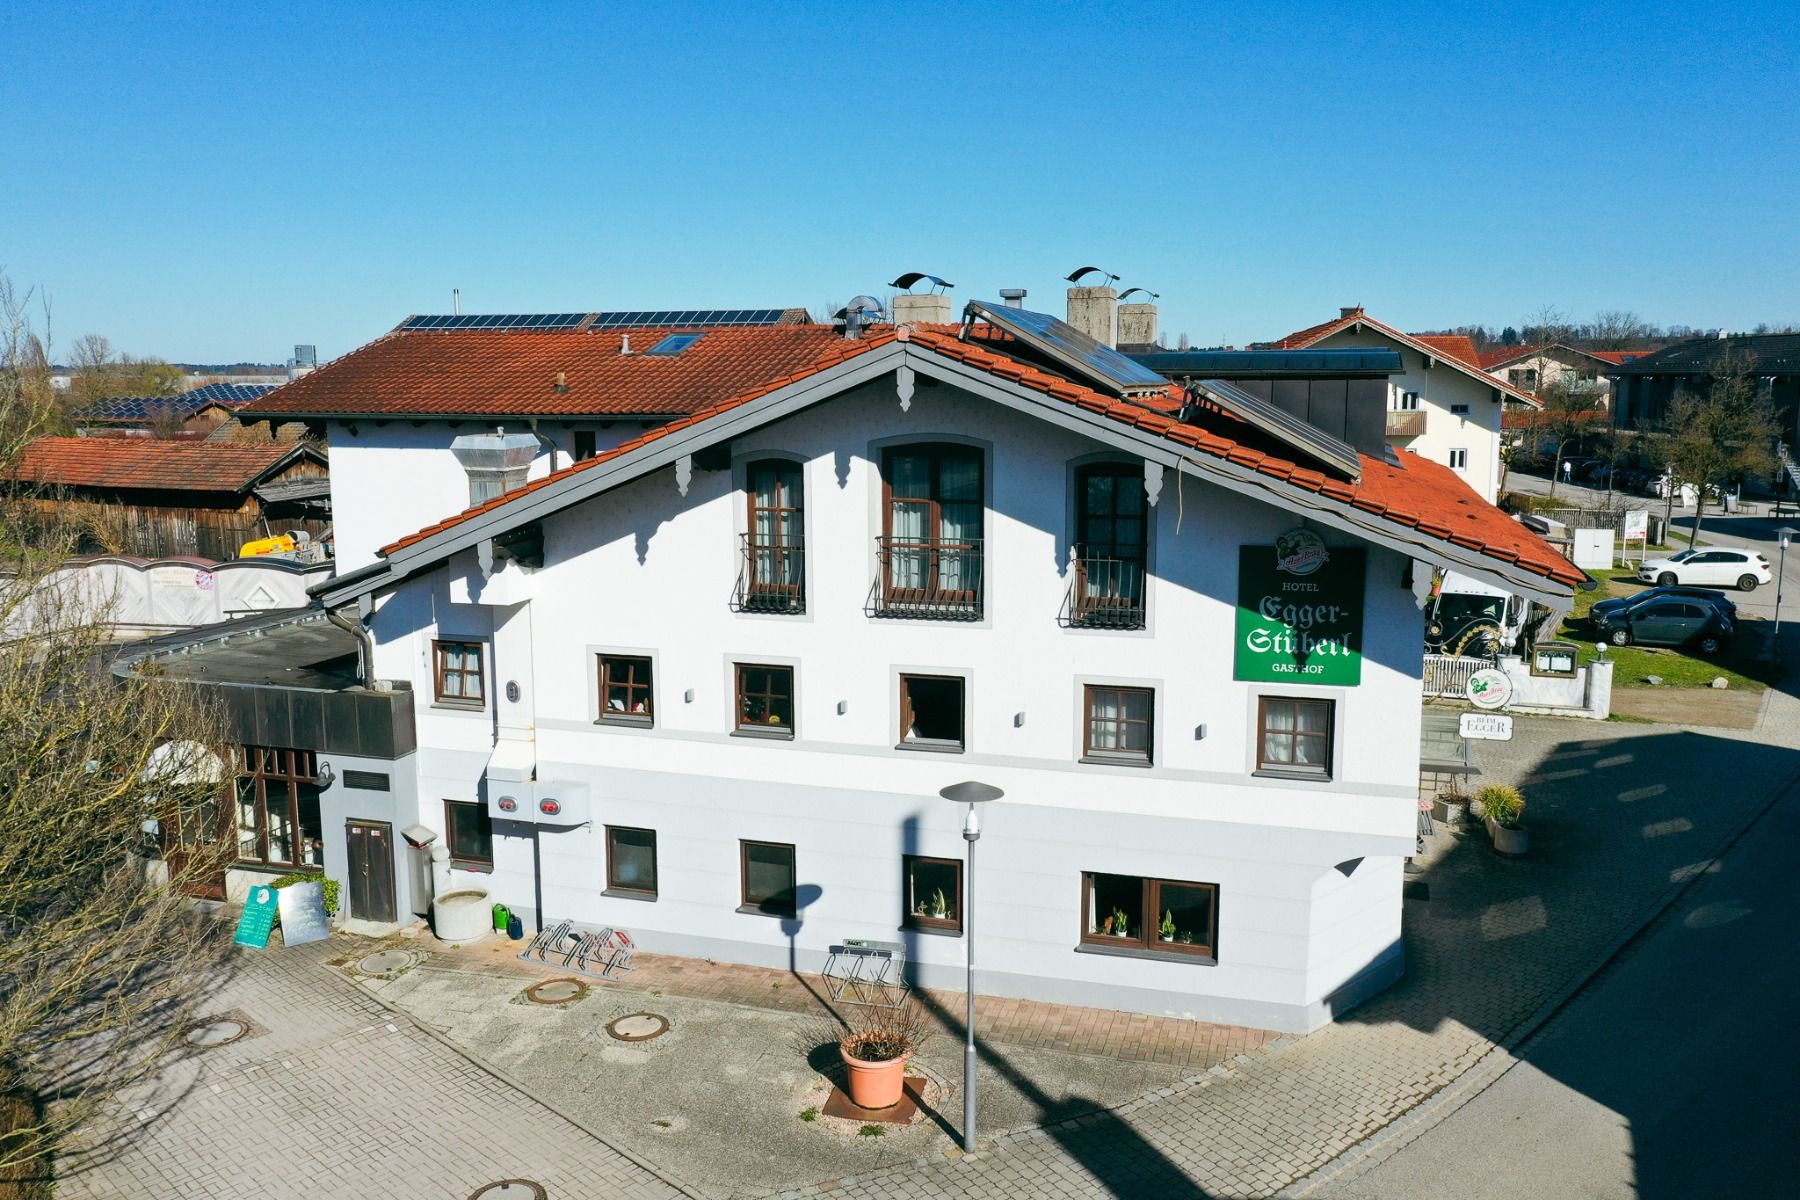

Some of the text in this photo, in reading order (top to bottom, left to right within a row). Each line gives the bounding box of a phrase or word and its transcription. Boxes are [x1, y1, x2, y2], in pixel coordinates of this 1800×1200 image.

[1282, 582, 1319, 591] HOTEL
[1259, 595, 1349, 629] Egger-
[1246, 628, 1352, 657] Stüberl
[1272, 663, 1324, 674] GASTHOF
[1467, 719, 1506, 733] EGGER
